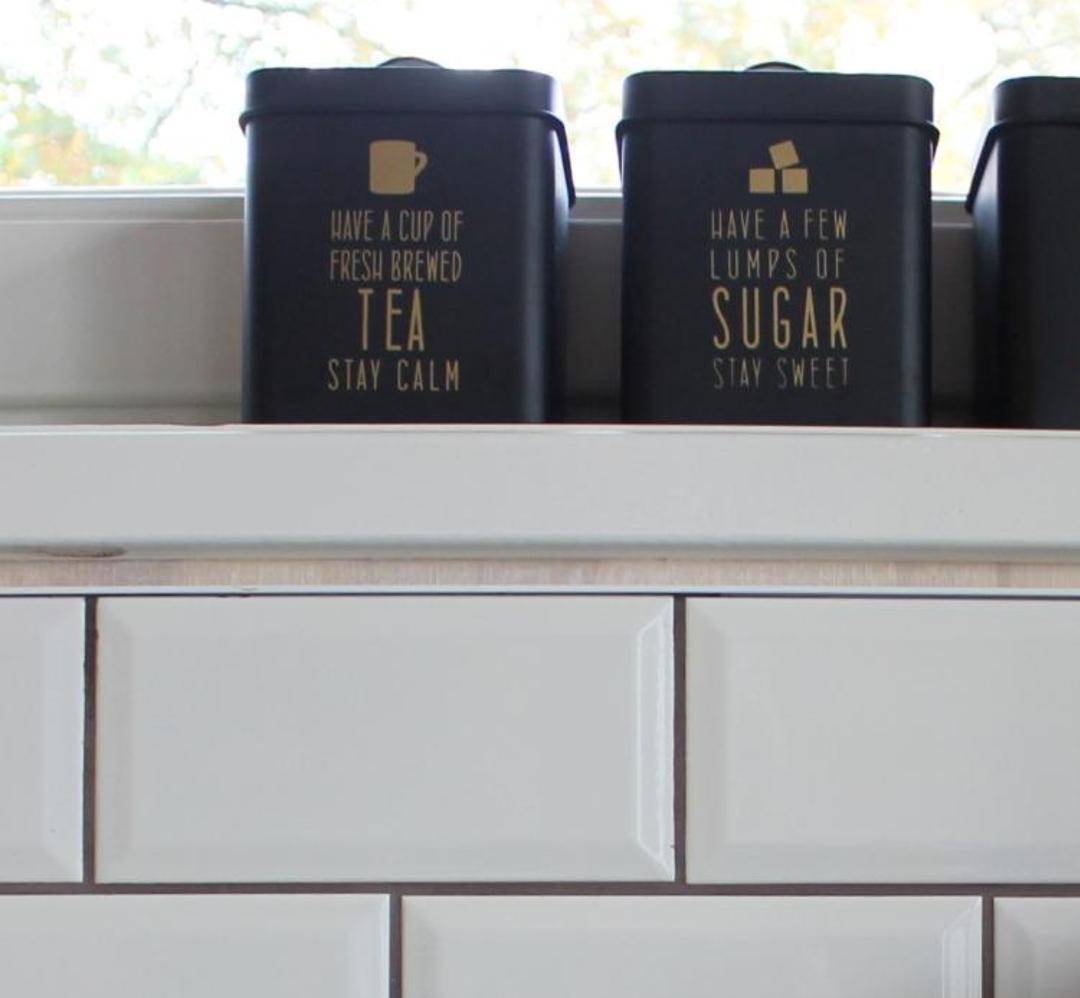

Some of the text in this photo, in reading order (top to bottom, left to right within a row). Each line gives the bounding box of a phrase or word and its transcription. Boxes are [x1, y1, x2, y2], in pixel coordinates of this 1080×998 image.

[331, 209, 463, 242] HAVE A CUP OF
[711, 208, 847, 240] HAVE A FEW
[330, 248, 462, 283] FRESH BREWED
[710, 248, 845, 280] LUMPS OF
[357, 287, 425, 352] TEA
[712, 285, 847, 350] SUGAR
[327, 358, 459, 392] STAY CALM
[713, 356, 849, 389] STAY SWEET
